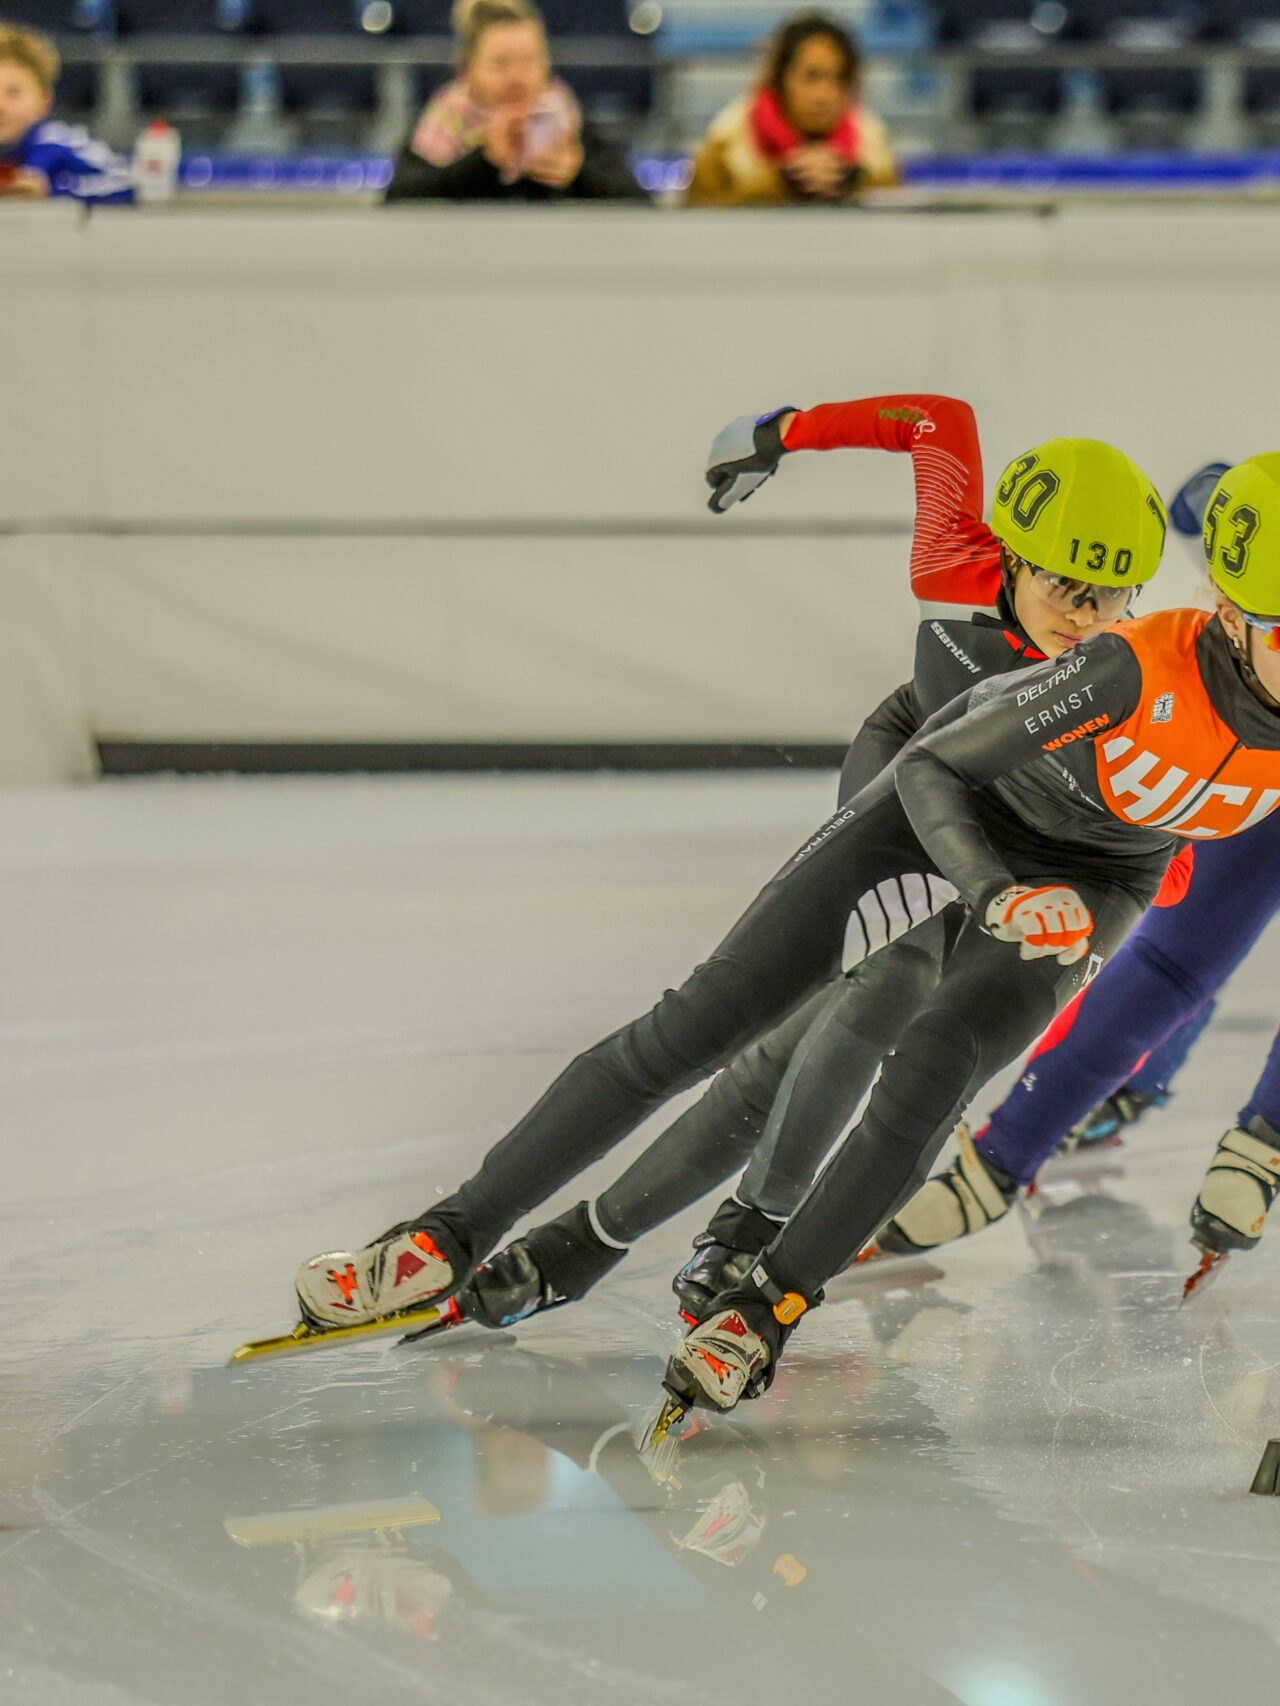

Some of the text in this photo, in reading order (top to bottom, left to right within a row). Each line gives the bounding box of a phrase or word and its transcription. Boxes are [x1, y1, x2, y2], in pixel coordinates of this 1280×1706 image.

[1069, 538, 1134, 578] 130
[1016, 656, 1087, 708] DELTRAP
[1024, 684, 1094, 735] ERNST
[1041, 713, 1111, 752] WONEN
